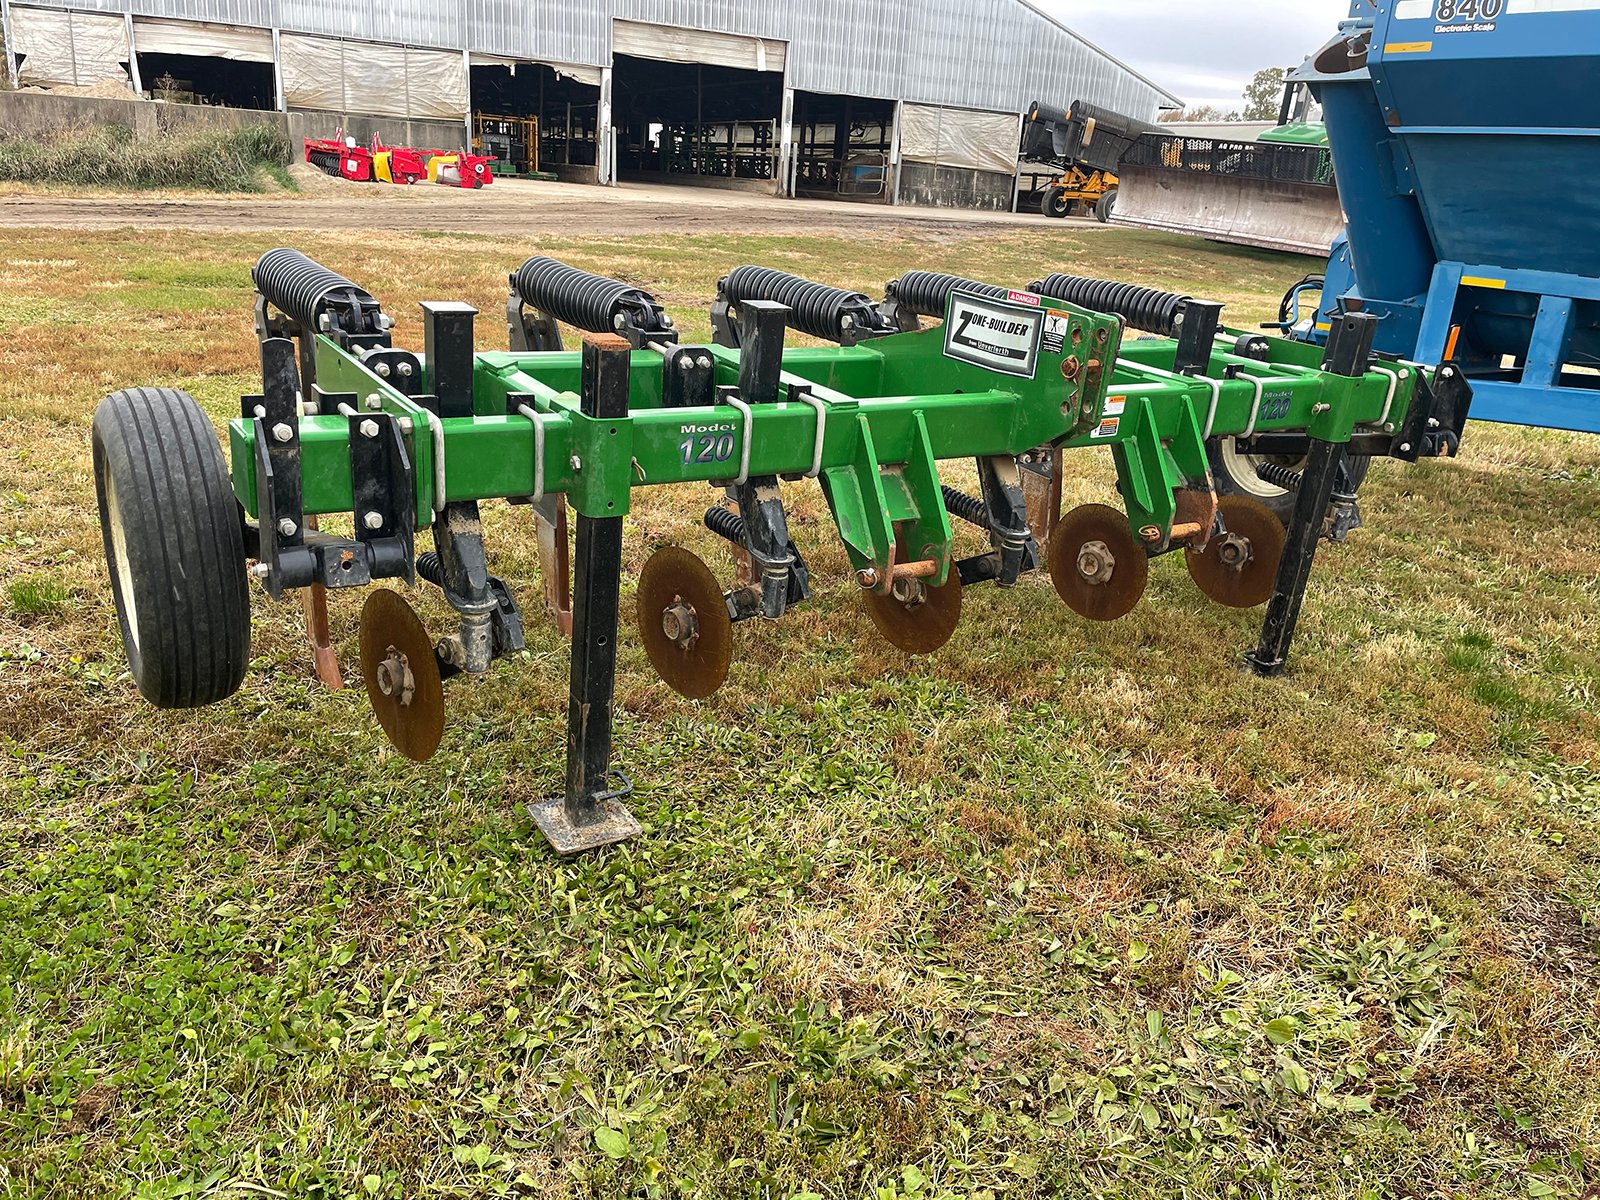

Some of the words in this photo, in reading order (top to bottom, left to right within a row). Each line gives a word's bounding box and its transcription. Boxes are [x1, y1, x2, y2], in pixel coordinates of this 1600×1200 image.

[1436, 0, 1503, 22] 840
[1434, 24, 1472, 33] Electronic
[1472, 23, 1495, 32] Scale
[1014, 294, 1038, 305] DANGER
[952, 310, 1029, 342] ZONE-BUILDER
[1263, 390, 1294, 398] Model
[1260, 398, 1290, 421] 120
[680, 423, 737, 433] Model
[680, 432, 735, 464] 120
